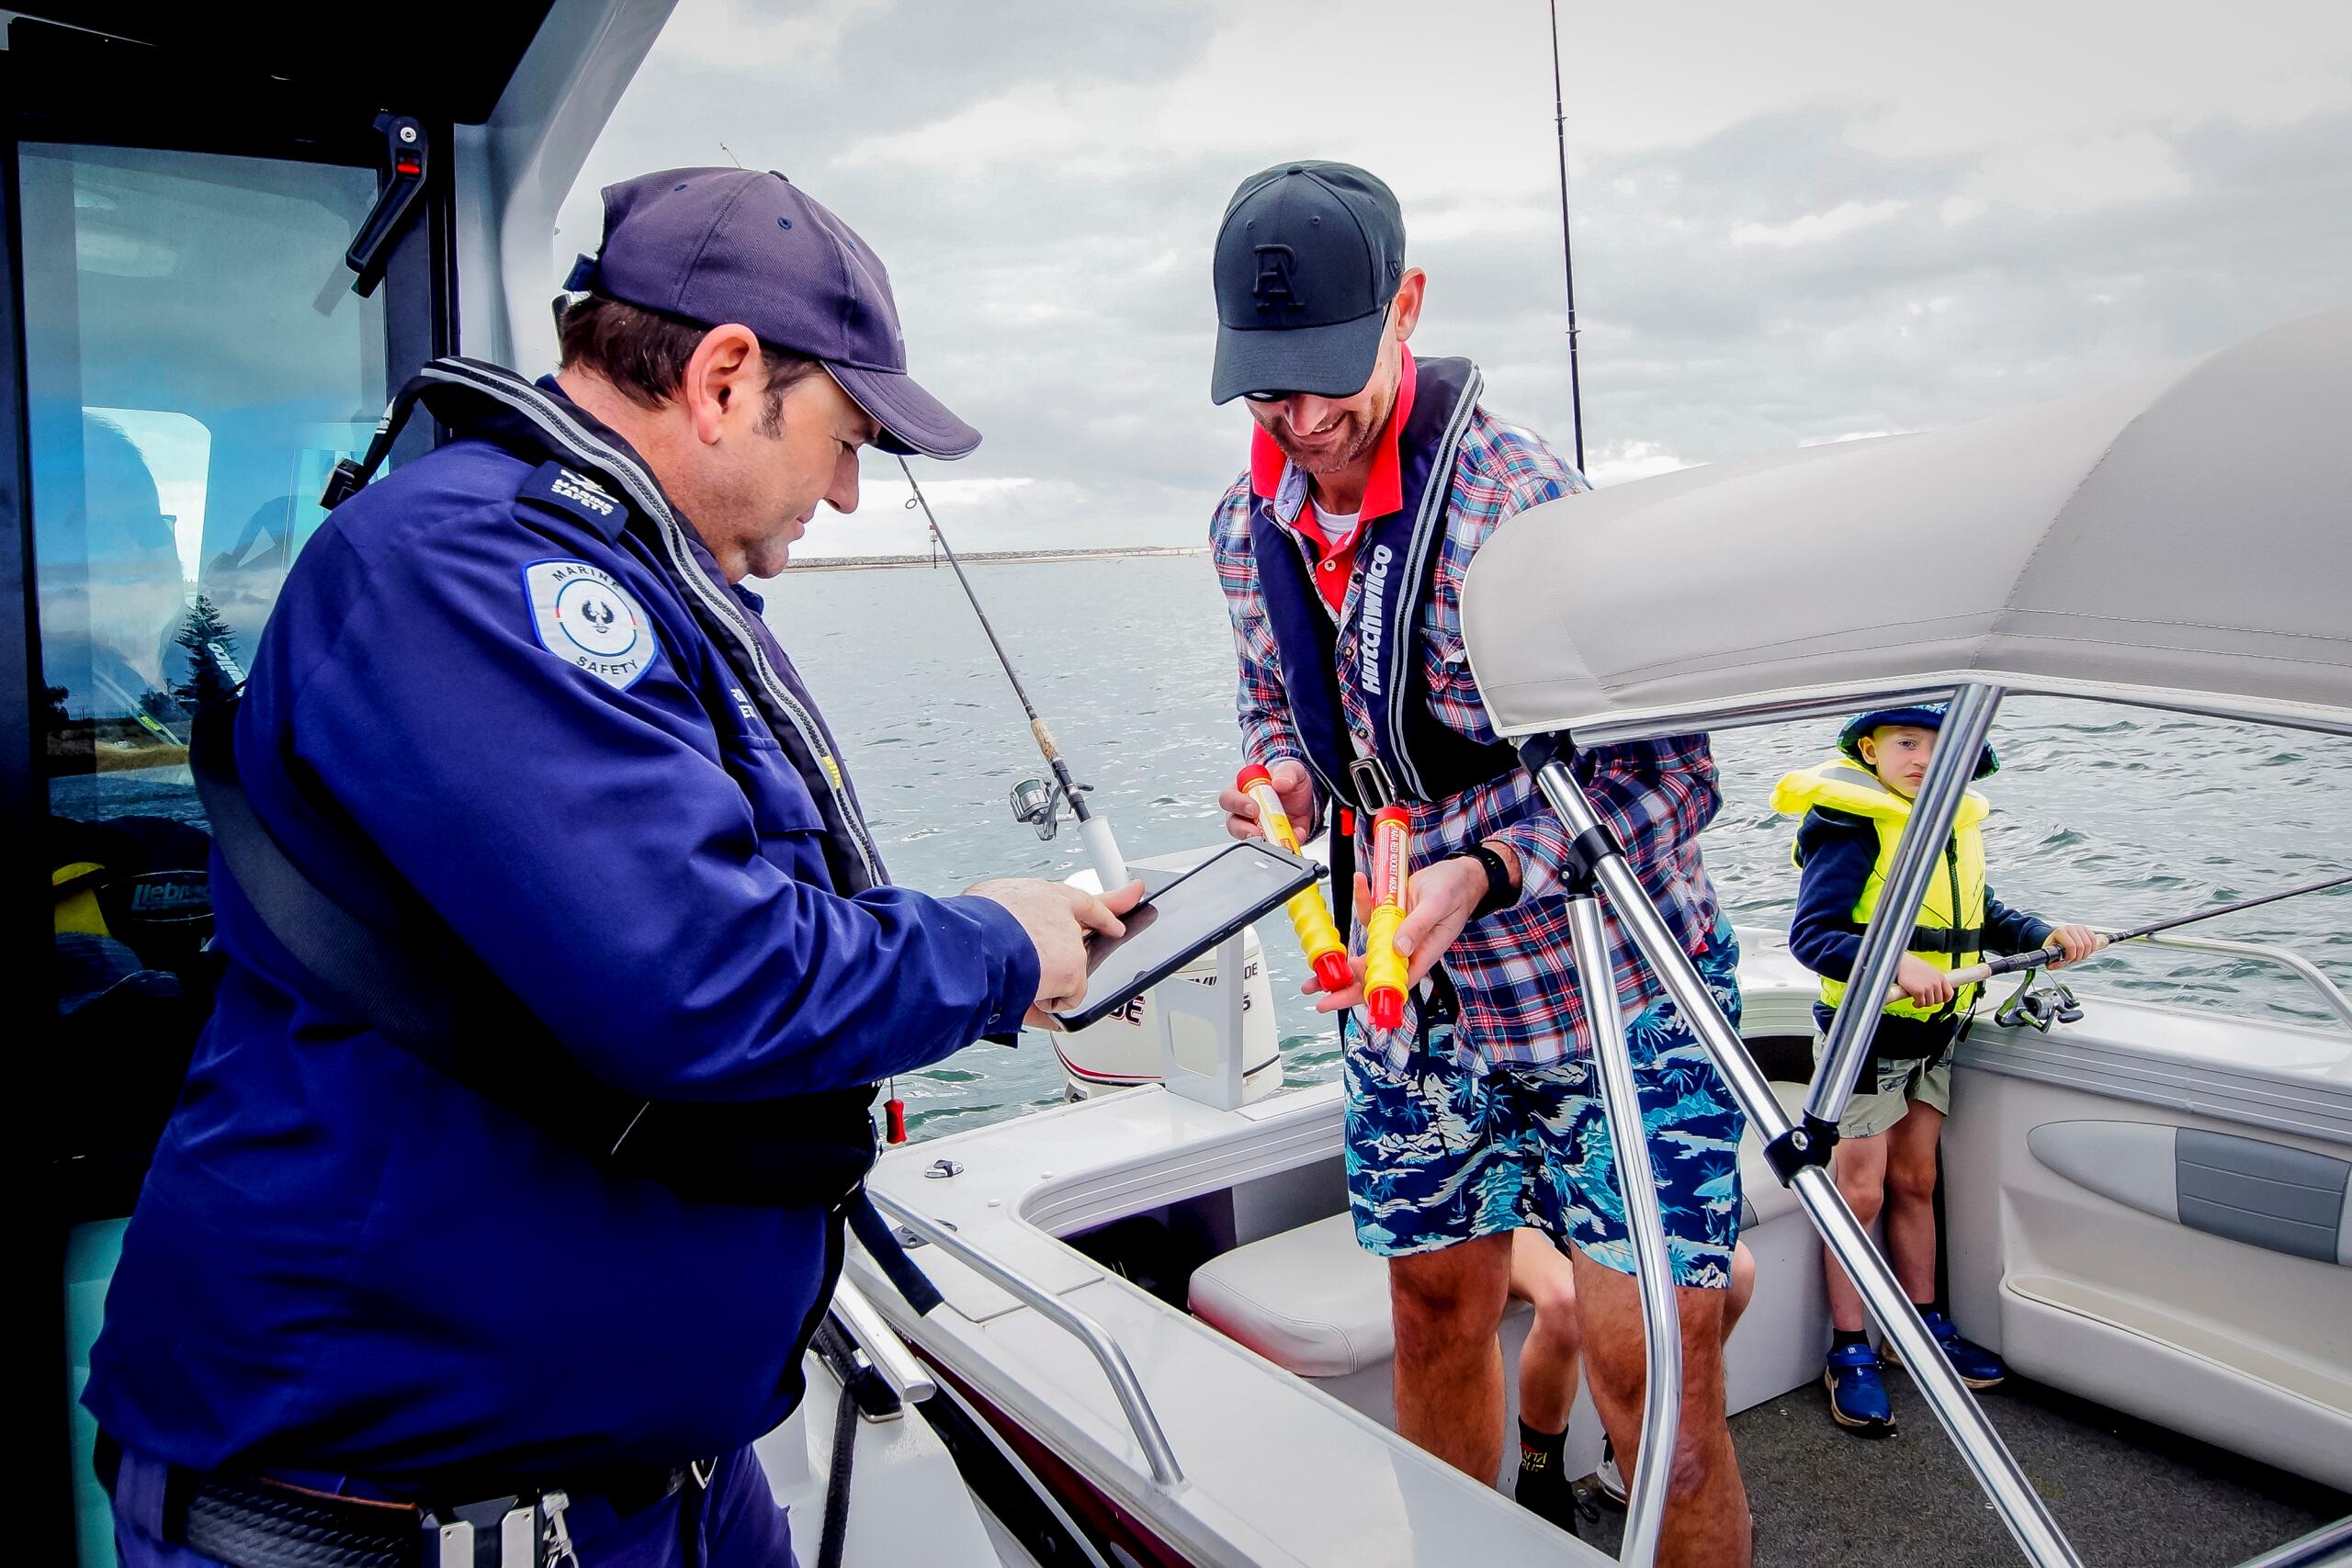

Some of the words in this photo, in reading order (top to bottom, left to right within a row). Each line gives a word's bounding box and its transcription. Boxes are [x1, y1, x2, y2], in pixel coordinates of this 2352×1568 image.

[551, 484, 612, 515] SAFETY
[554, 479, 614, 511] MARINE
[551, 566, 622, 590] MARINE
[1360, 545, 1393, 695] Hutchwilco
[576, 656, 638, 674] SAFETY
[1389, 853, 1397, 875] ROCKET
